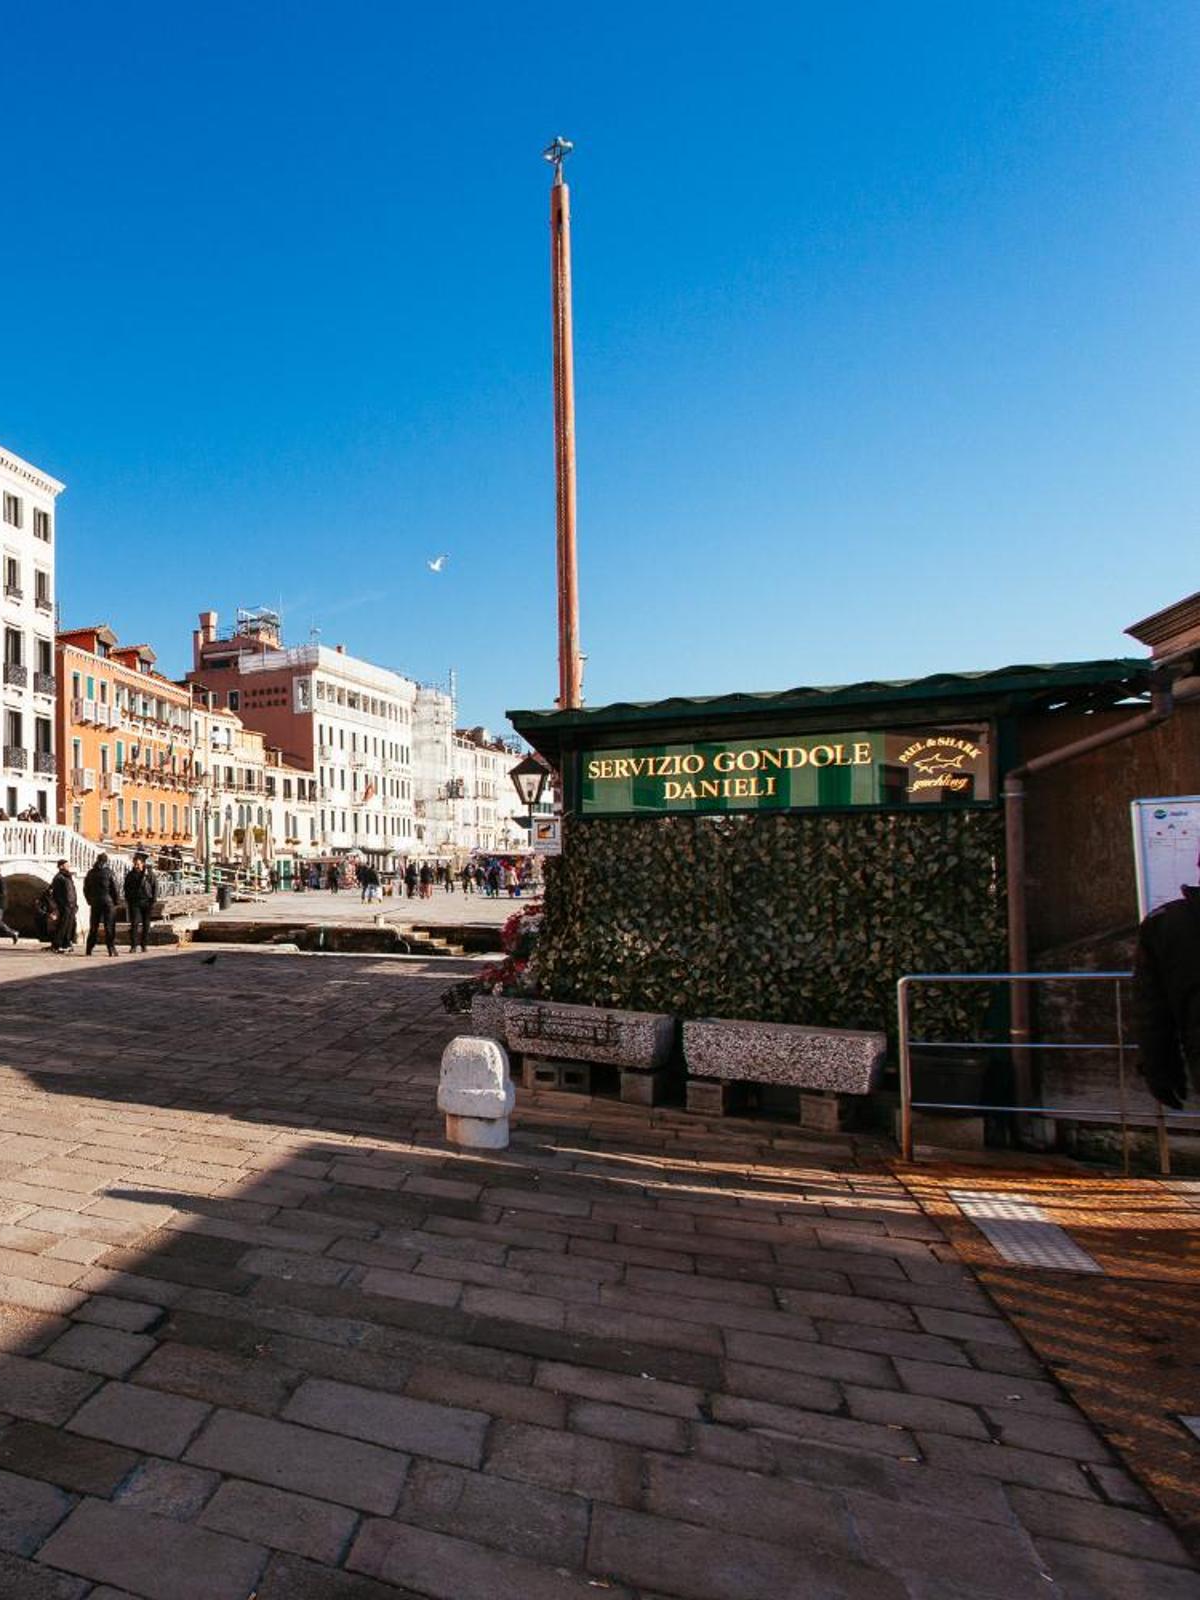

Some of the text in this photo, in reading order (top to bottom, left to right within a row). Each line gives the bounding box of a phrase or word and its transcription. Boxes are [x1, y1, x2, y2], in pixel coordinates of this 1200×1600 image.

[588, 742, 873, 780] SERVIZIO GONDOLE
[899, 742, 926, 763] PAUL
[937, 737, 983, 759] SHARK
[663, 776, 776, 800] DANIELI
